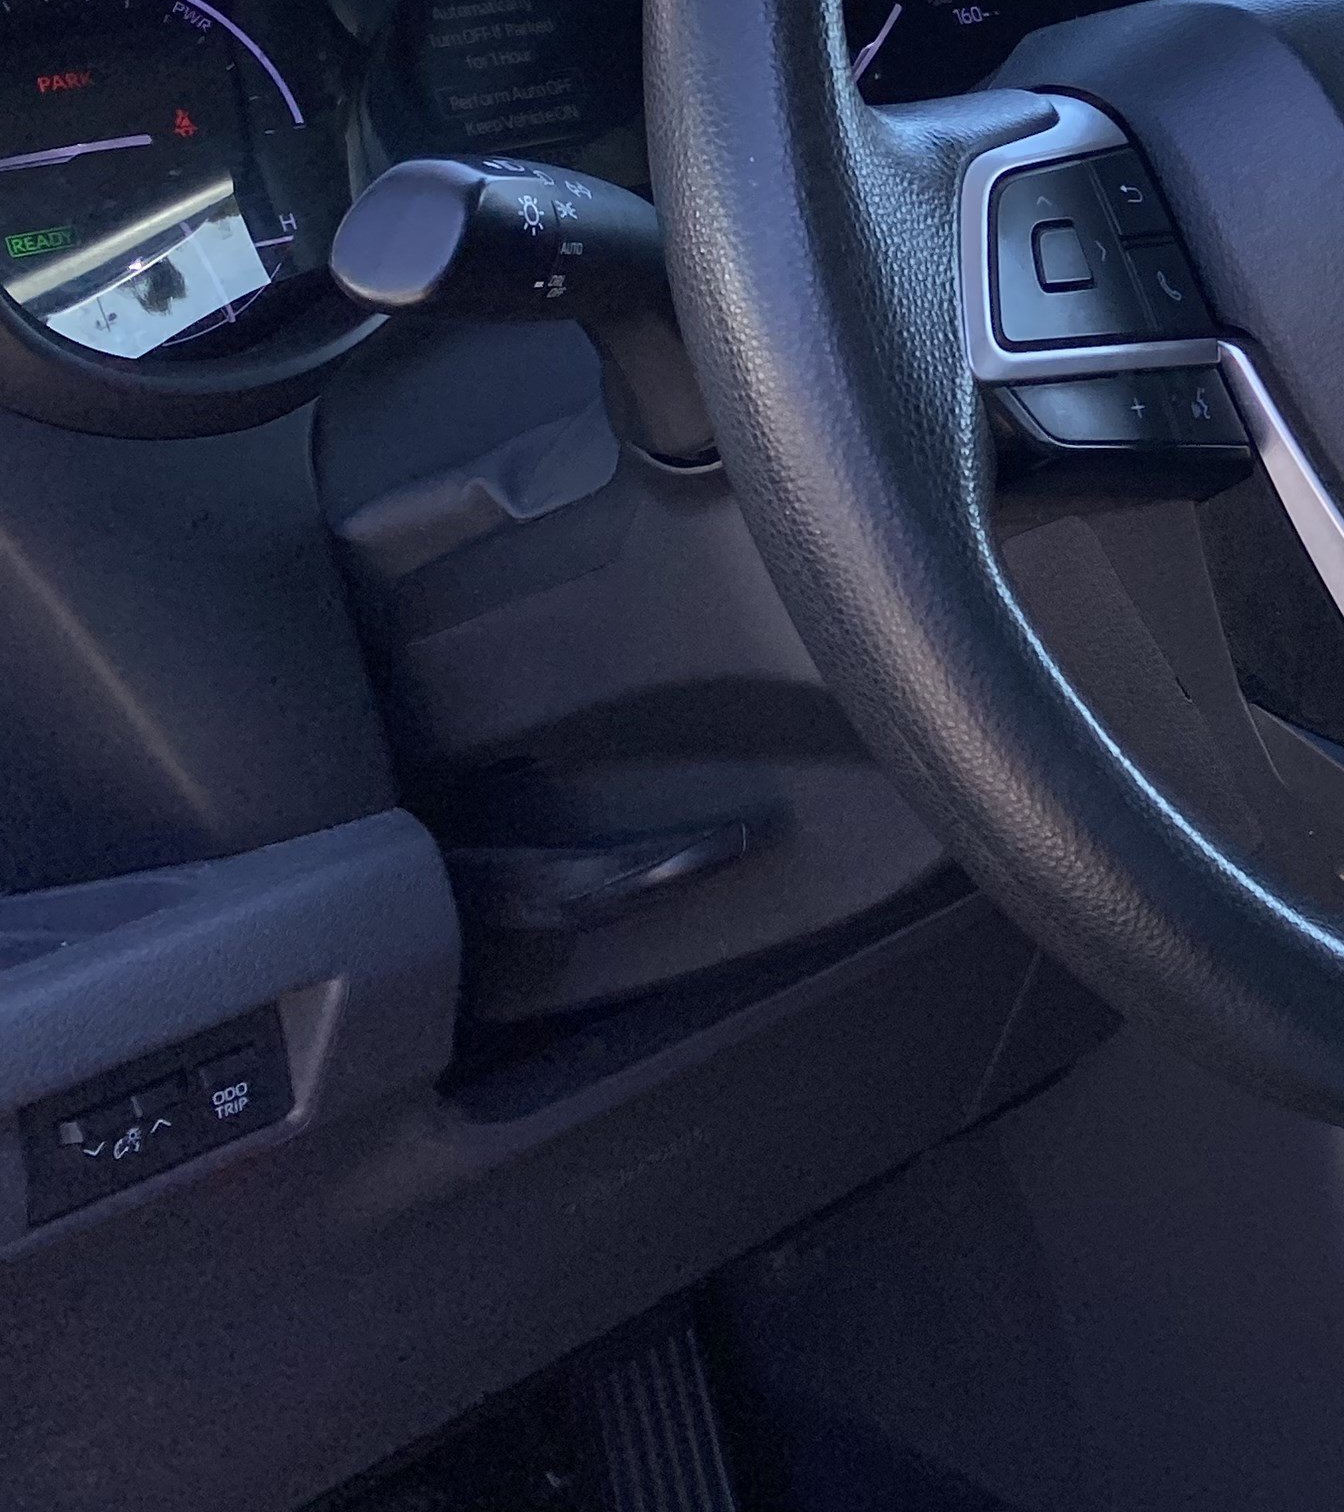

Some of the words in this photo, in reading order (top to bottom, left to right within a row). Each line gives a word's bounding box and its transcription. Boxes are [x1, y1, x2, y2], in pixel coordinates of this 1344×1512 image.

[172, 0, 212, 33] PWR
[952, 5, 984, 25] 160
[37, 71, 93, 93] PARK
[279, 212, 298, 233] H
[12, 232, 78, 253] READY
[560, 242, 584, 256] AUTO
[211, 1082, 248, 1106] ODO
[214, 1096, 249, 1120] TRIP
